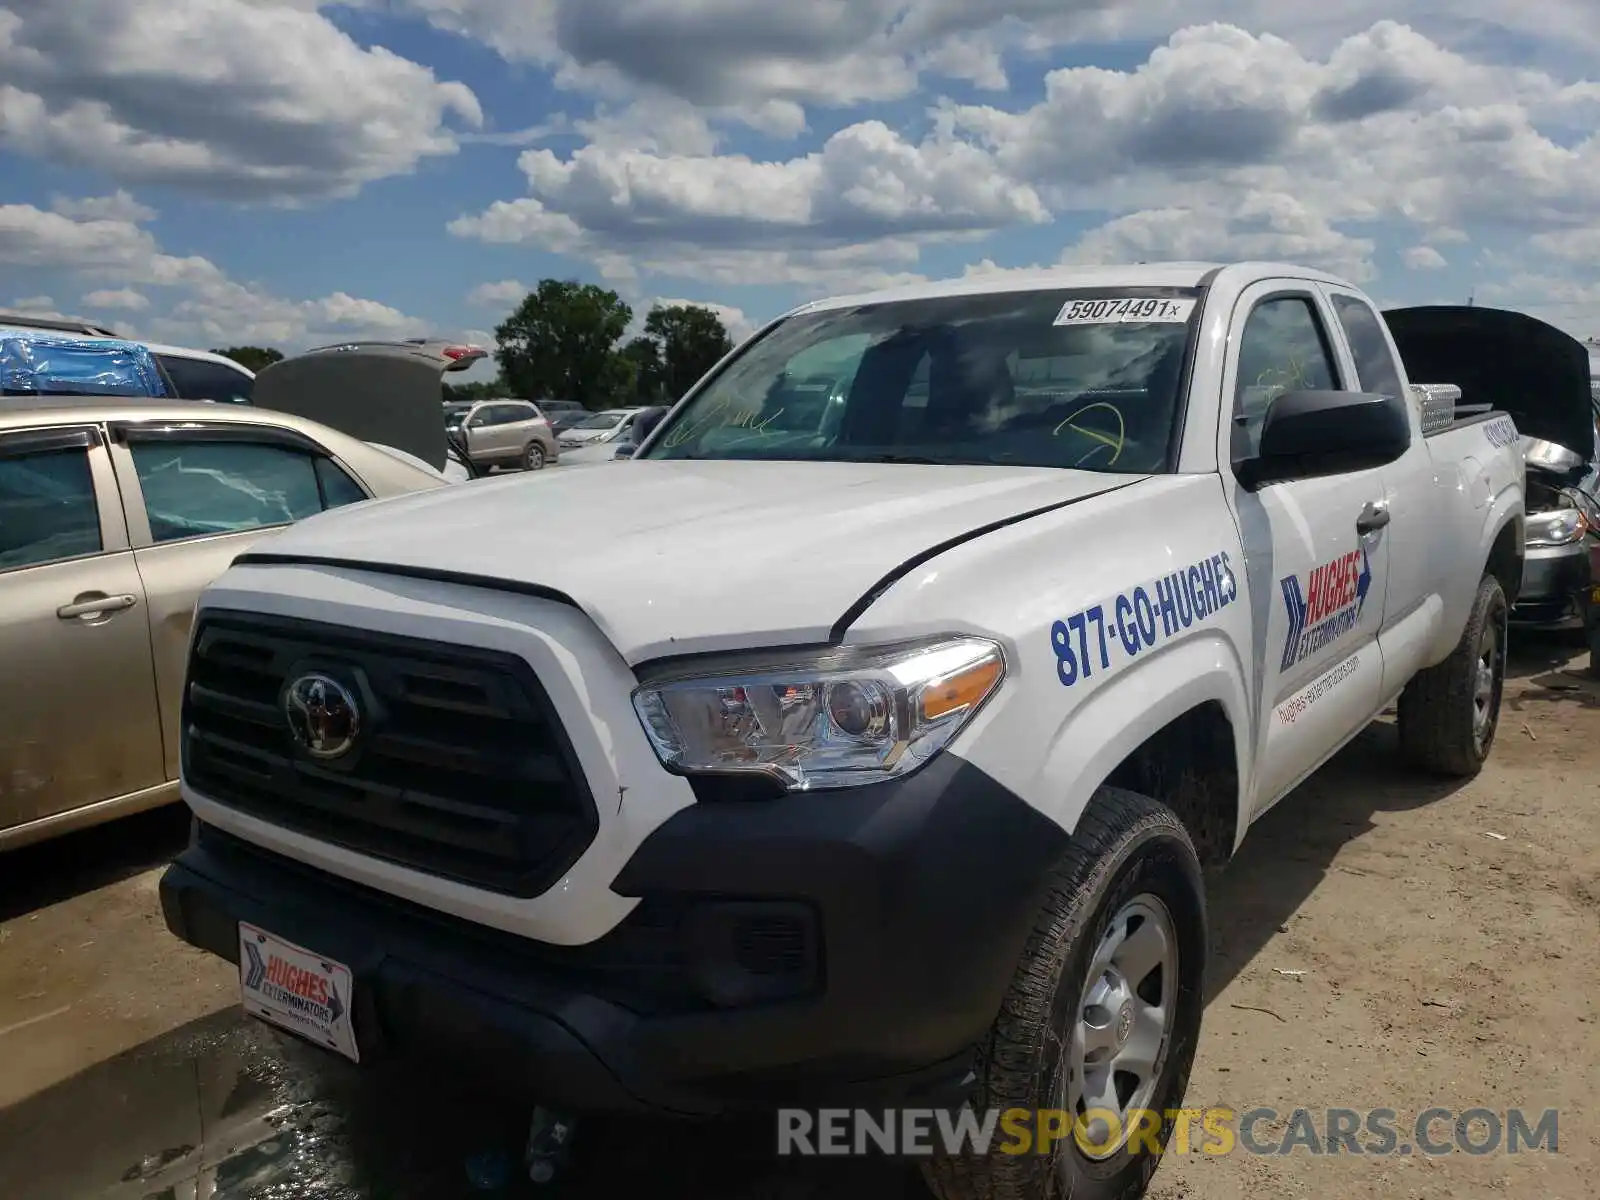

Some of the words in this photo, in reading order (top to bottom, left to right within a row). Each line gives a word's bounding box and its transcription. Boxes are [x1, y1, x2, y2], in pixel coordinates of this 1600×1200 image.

[1304, 549, 1360, 627] HUGHES
[1051, 551, 1237, 687] 877-GO-HUGHES
[1298, 604, 1358, 660] EXTERMINATORS
[262, 981, 330, 1023] EXTERMINATORS
[266, 954, 329, 1004] HUGHES
